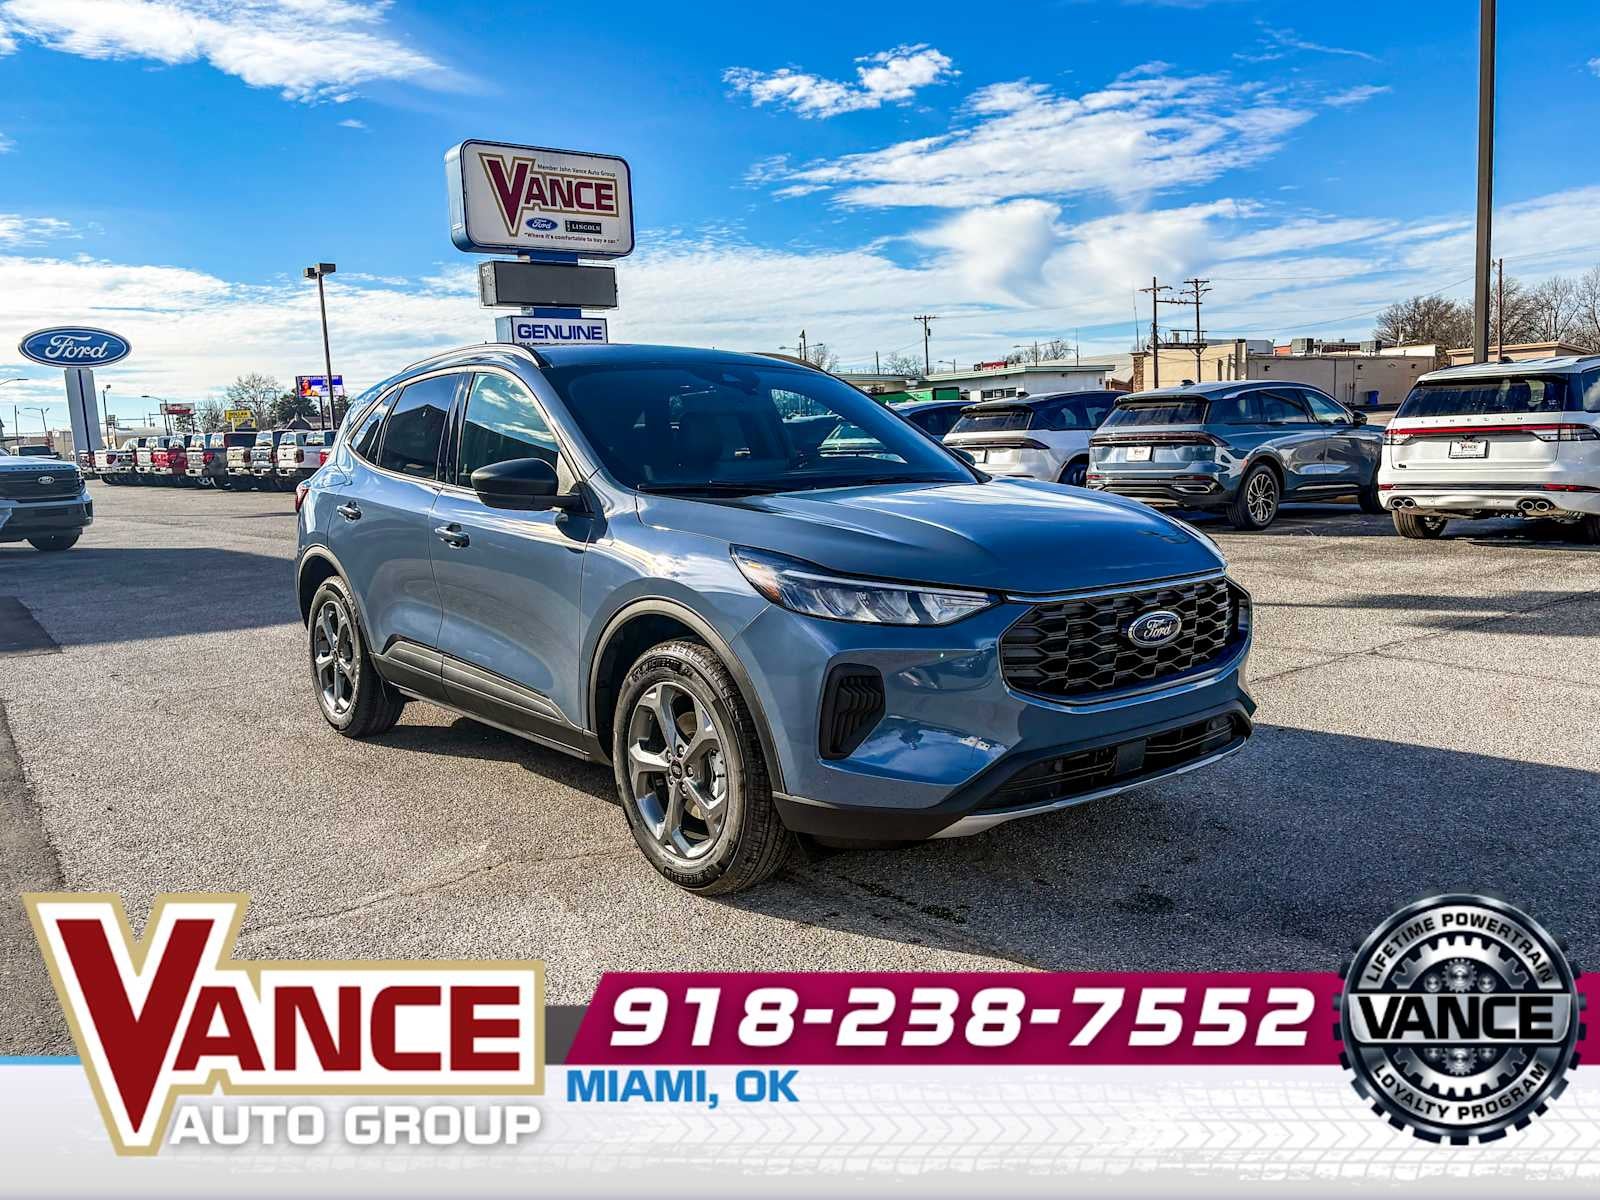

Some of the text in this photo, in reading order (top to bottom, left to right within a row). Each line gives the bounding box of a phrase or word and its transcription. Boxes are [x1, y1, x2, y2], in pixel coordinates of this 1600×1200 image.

[537, 163, 558, 171] Member
[601, 169, 616, 178] Group
[486, 159, 614, 230] VANCE
[531, 219, 552, 229] Ford
[572, 222, 601, 232] LINCOLN
[555, 234, 586, 243] comfortable
[517, 323, 603, 340] GENUINE
[44, 334, 109, 359] Ford
[1143, 619, 1173, 639] Ford
